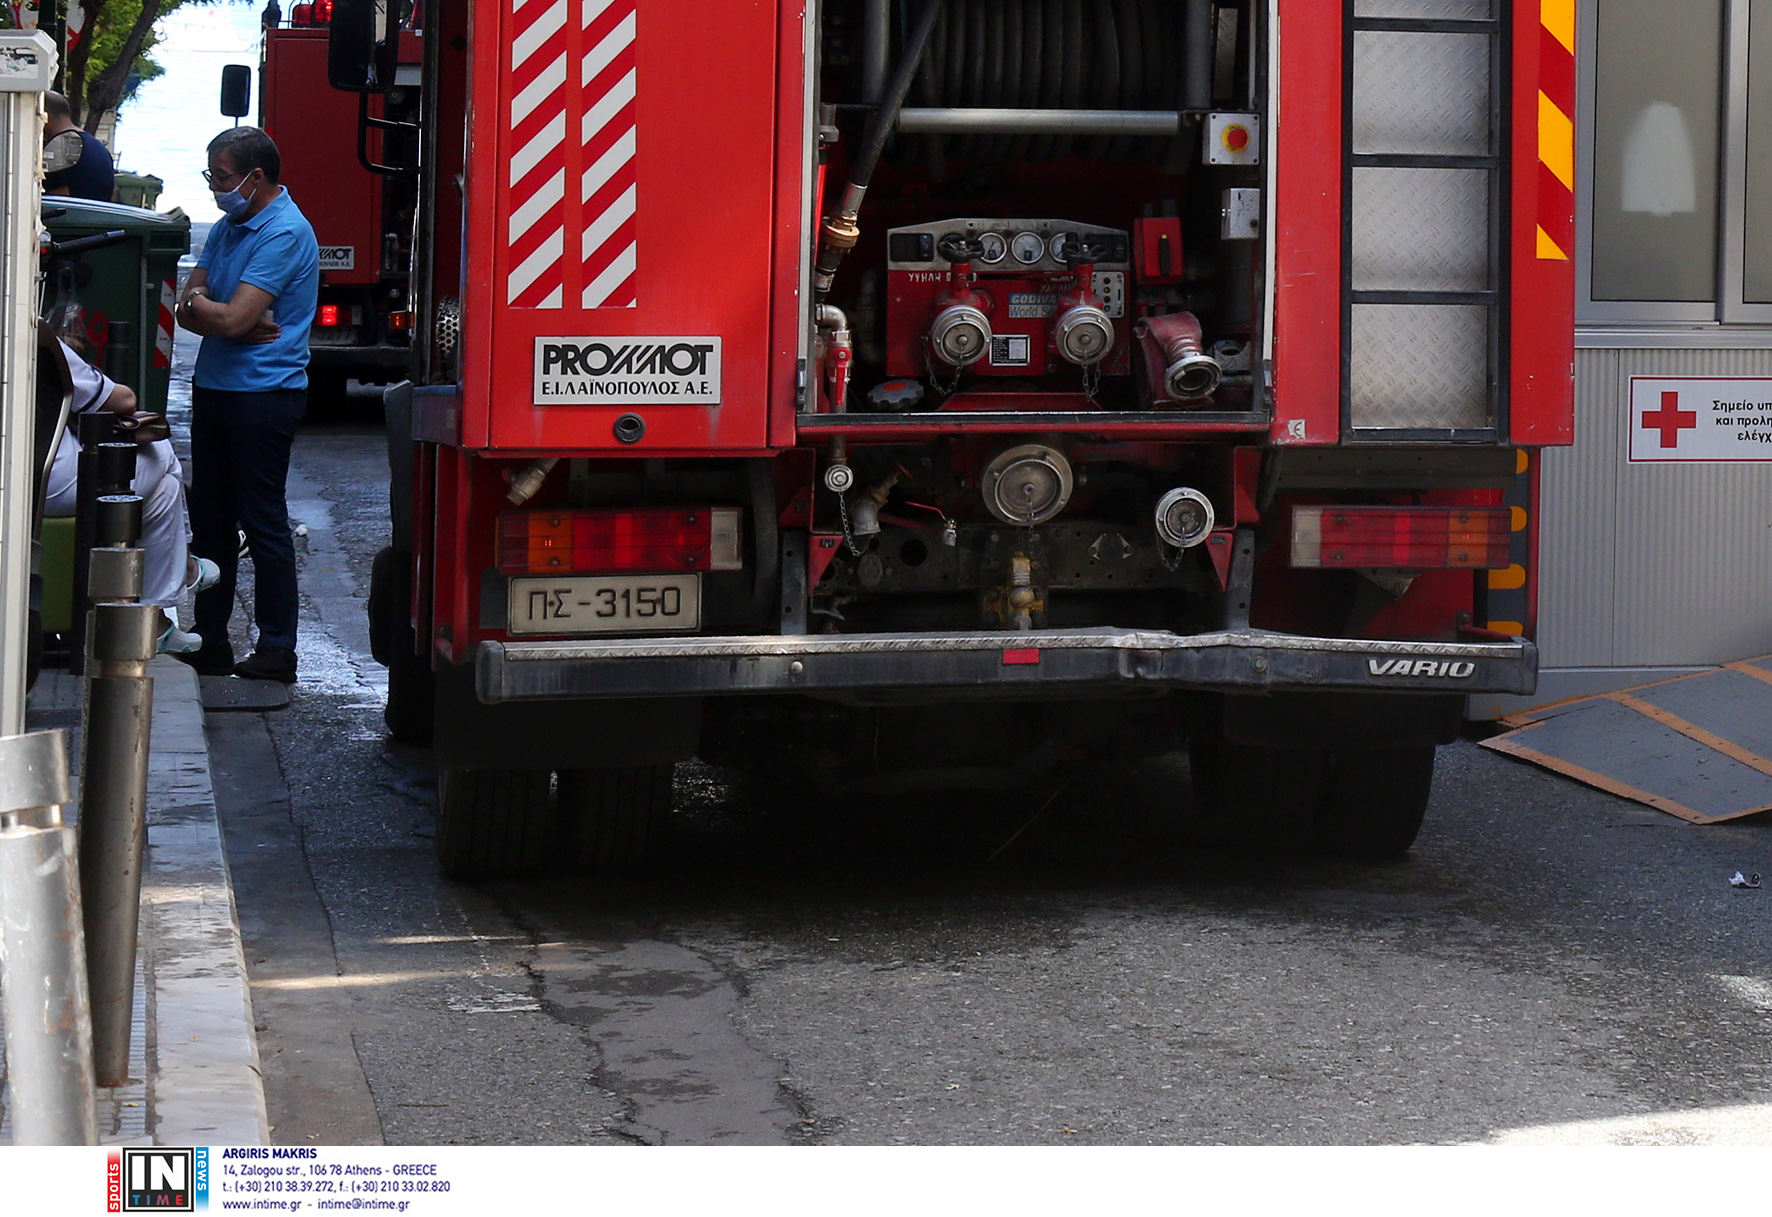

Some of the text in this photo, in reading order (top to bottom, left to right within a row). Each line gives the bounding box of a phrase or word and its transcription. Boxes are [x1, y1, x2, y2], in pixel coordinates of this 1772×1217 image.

[1009, 305, 1040, 318] World
[684, 381, 713, 395] Α.Ε.
[1712, 400, 1754, 413] Σημείο
[1715, 417, 1734, 426] και
[528, 587, 681, 620] ΠΣ-3150
[1368, 659, 1475, 678] VARIO
